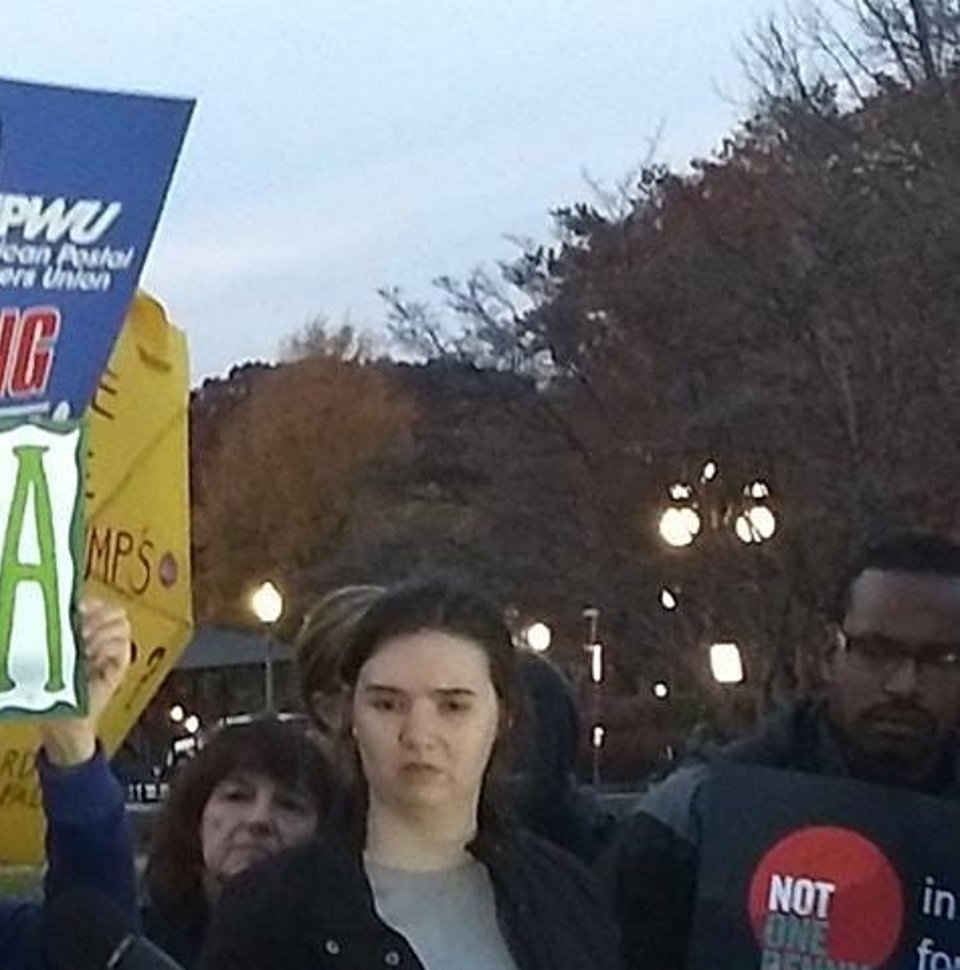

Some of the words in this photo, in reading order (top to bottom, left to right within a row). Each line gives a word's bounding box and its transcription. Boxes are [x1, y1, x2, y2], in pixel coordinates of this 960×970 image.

[56, 243, 135, 270] Postal
[42, 264, 111, 292] Union
[769, 873, 836, 918] NOT
[923, 876, 956, 920] in
[764, 913, 830, 951] ONE
